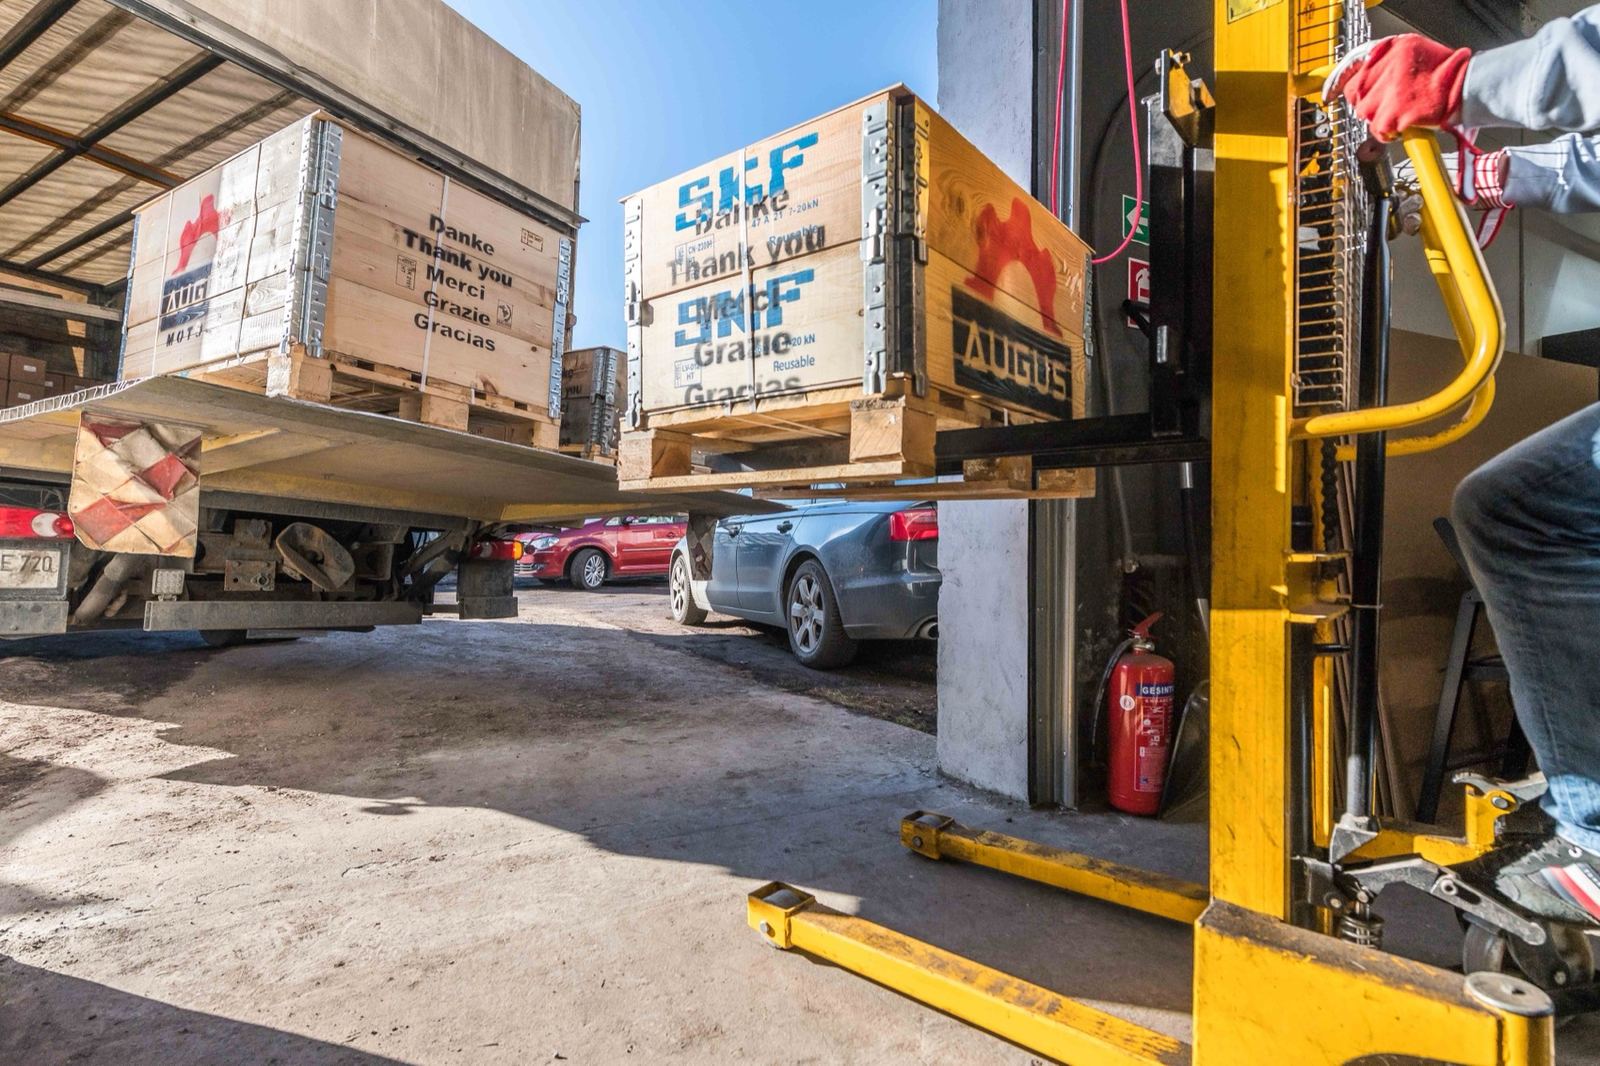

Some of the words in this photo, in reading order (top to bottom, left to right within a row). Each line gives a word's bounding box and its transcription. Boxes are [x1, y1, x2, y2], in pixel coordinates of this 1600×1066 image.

[675, 131, 819, 231] SKF
[429, 213, 495, 257] Danke
[695, 189, 789, 236] Danke
[403, 228, 473, 273] Thank
[478, 263, 513, 288] you
[666, 242, 756, 287] Thank
[766, 224, 825, 271] you
[426, 264, 486, 301] Merci
[423, 290, 491, 327] Grazie
[674, 268, 815, 348] SKF
[414, 312, 496, 352] Gracias
[773, 354, 816, 372] Reusable
[962, 320, 1067, 401] AUGUS
[1142, 685, 1174, 695] GESINT
